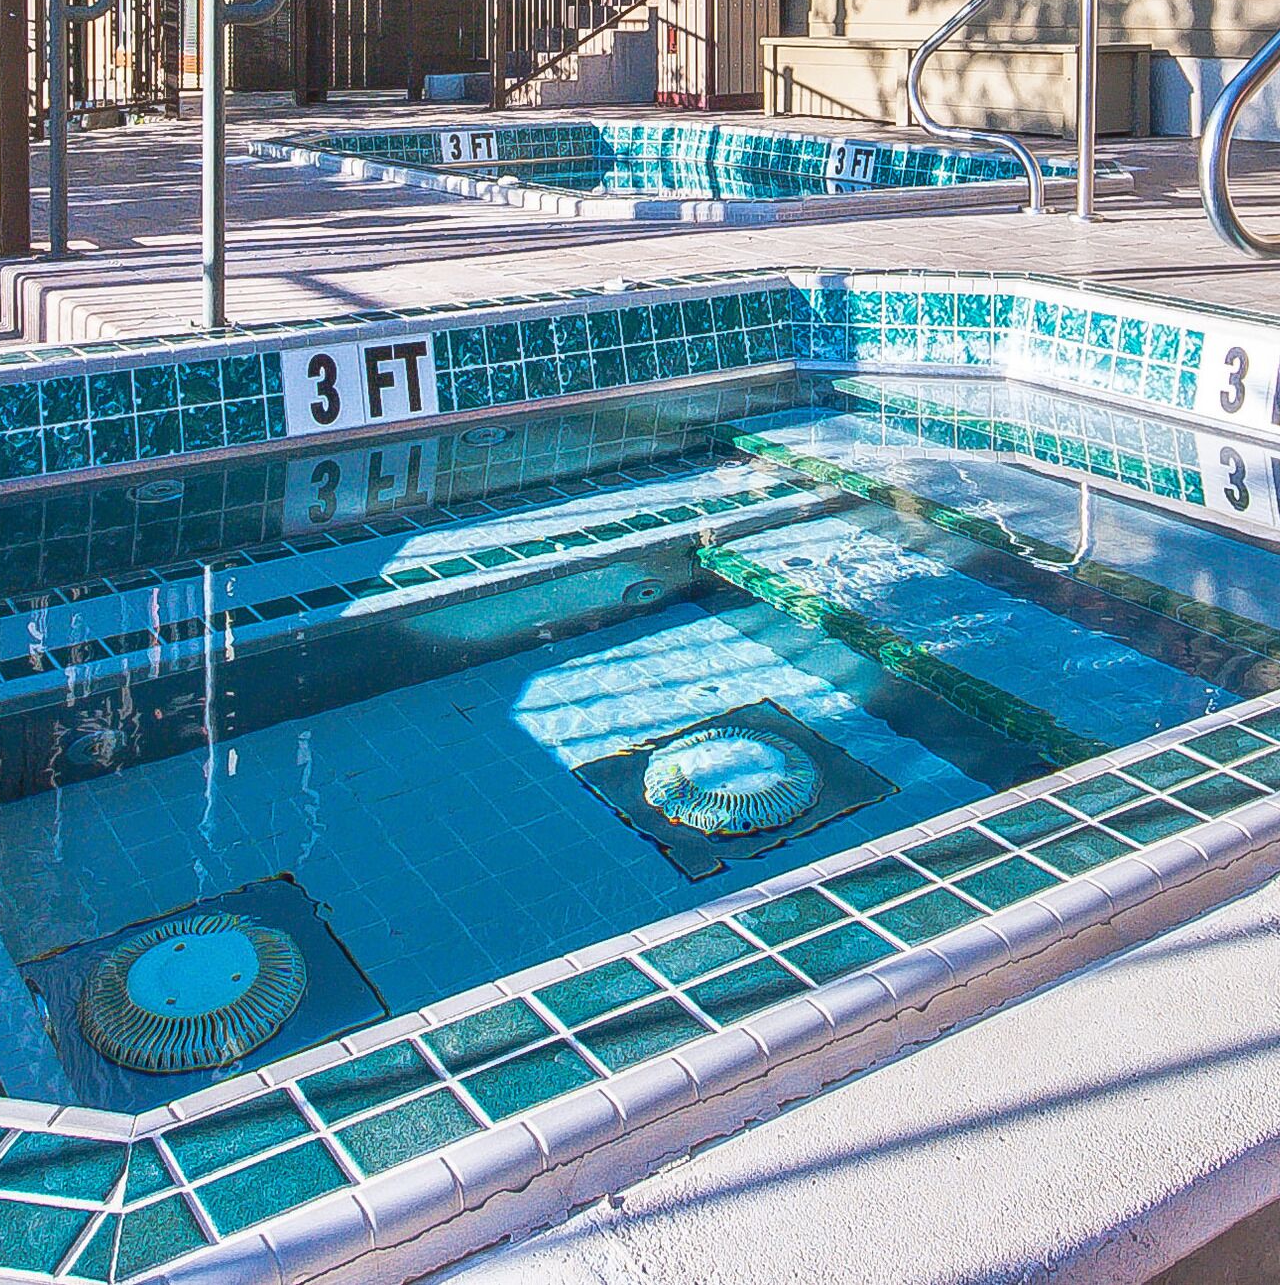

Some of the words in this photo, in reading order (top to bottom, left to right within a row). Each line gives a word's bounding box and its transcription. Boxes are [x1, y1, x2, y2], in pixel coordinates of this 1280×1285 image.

[449, 134, 462, 160] 3
[470, 133, 494, 159] FT
[834, 146, 846, 175] 3
[850, 148, 875, 179] FT
[307, 353, 341, 425] 3
[364, 340, 428, 418] FT
[1220, 346, 1250, 414] 3
